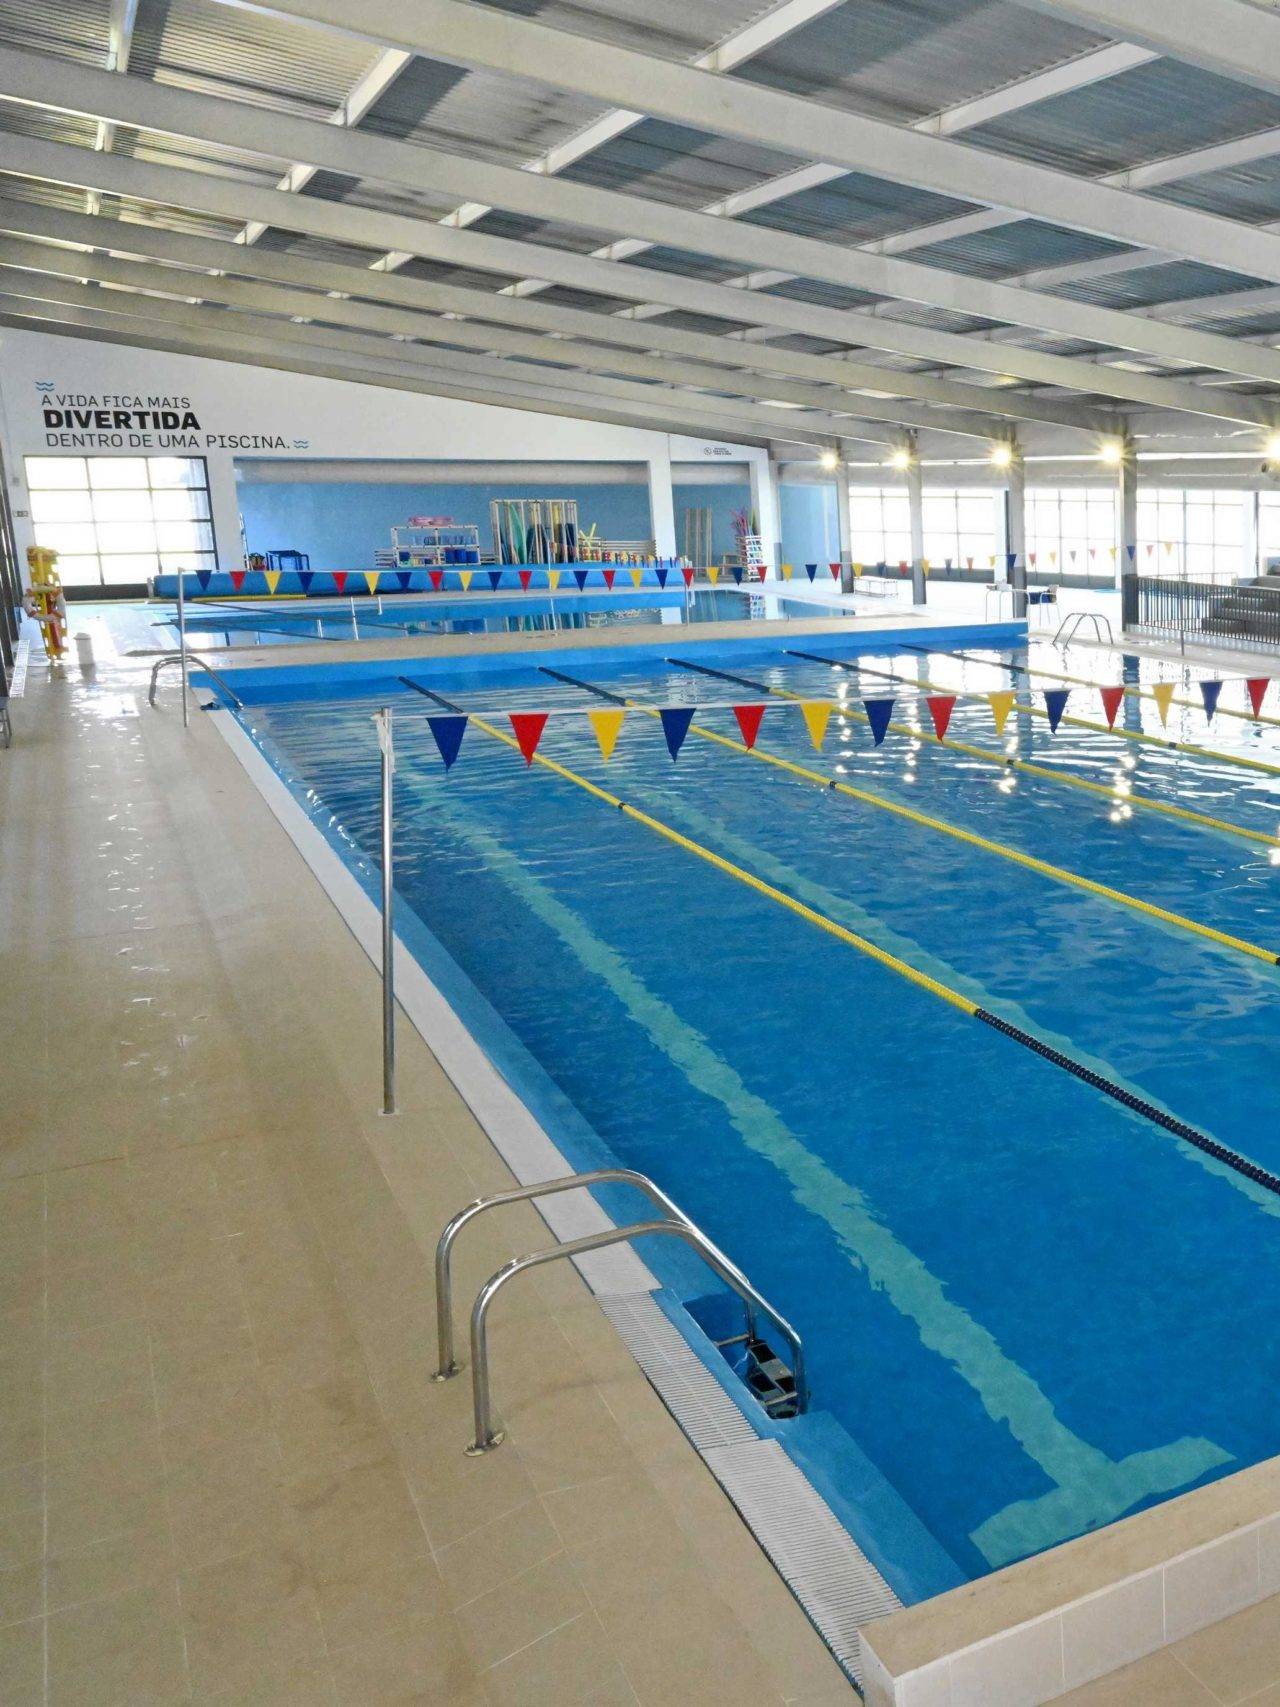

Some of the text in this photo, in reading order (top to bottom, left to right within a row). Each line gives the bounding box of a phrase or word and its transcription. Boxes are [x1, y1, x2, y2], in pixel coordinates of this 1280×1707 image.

[41, 394, 191, 409] A VIDA FICA MAIS
[43, 409, 201, 430] DIVERTIDA
[46, 433, 290, 449] DENTRO DE UMA PISCINA.
